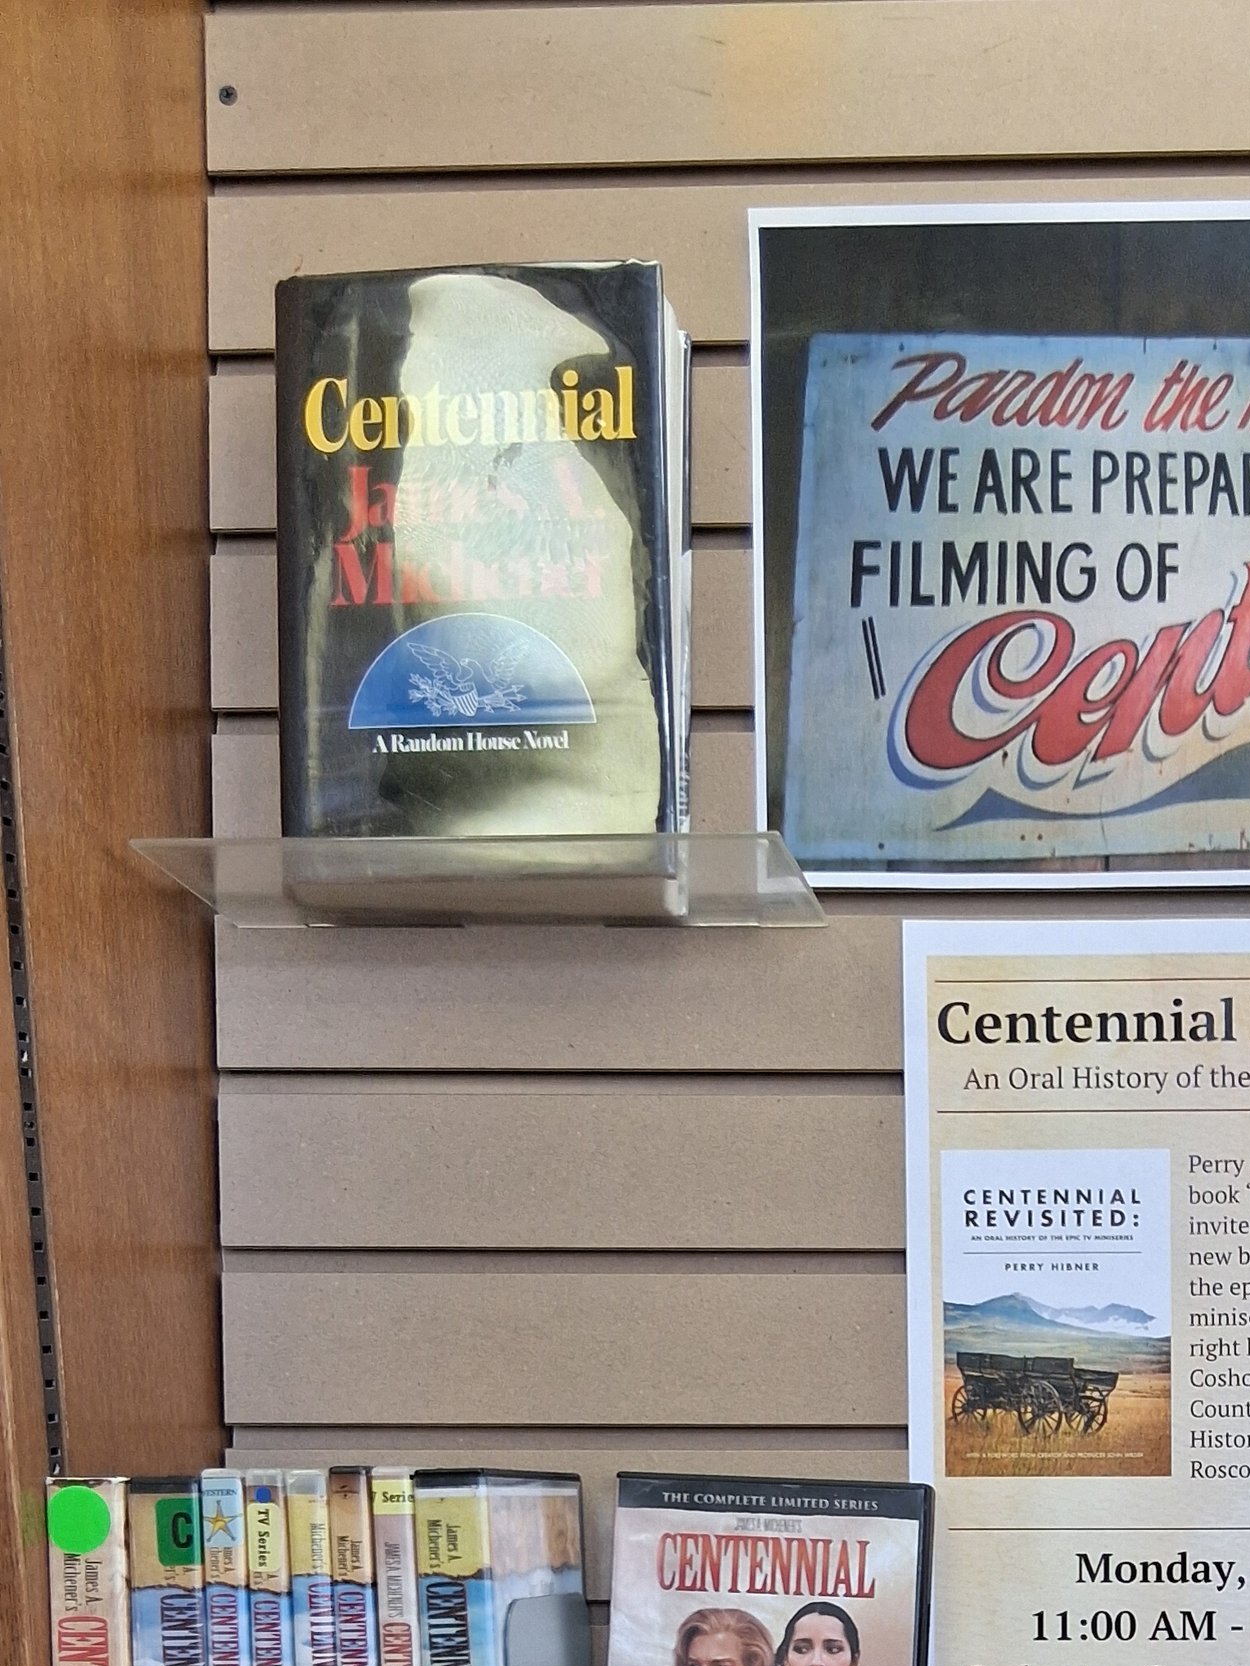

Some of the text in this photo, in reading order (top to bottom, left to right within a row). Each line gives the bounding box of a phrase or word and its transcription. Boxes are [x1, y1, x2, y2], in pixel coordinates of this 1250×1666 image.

[871, 352, 1135, 431] Pardon
[1144, 359, 1234, 433] the
[305, 366, 637, 453] Centennial
[878, 447, 960, 514] WE
[973, 447, 1074, 516] ARE
[850, 540, 1180, 607] FILMING OF
[373, 729, 570, 753] A Random House Novel
[937, 997, 1238, 1045] Centennial
[962, 1067, 1001, 1091] An
[1008, 1065, 1064, 1090] Oral
[1072, 1065, 1169, 1095] History
[1176, 1064, 1204, 1089] of
[1209, 1064, 1250, 1089] the
[1188, 1154, 1245, 1178] Perry
[963, 1188, 1141, 1206] CENTENNIAL
[1188, 1184, 1241, 1205] book
[965, 1209, 1139, 1228] REVISITED:
[1004, 1262, 1099, 1272] PERRY HIBNER
[1188, 1251, 1233, 1266] new
[1189, 1276, 1224, 1297] the
[1189, 1337, 1241, 1361] right
[662, 1491, 879, 1511] THE COMPLETE LIMITED SERIES
[171, 1511, 194, 1550] C
[257, 1508, 272, 1568] TV Series
[656, 1532, 876, 1599] CENTENNIAL
[1075, 1551, 1246, 1592] Monday,
[1032, 1610, 1137, 1641] 11:00
[1148, 1610, 1217, 1641] AM
